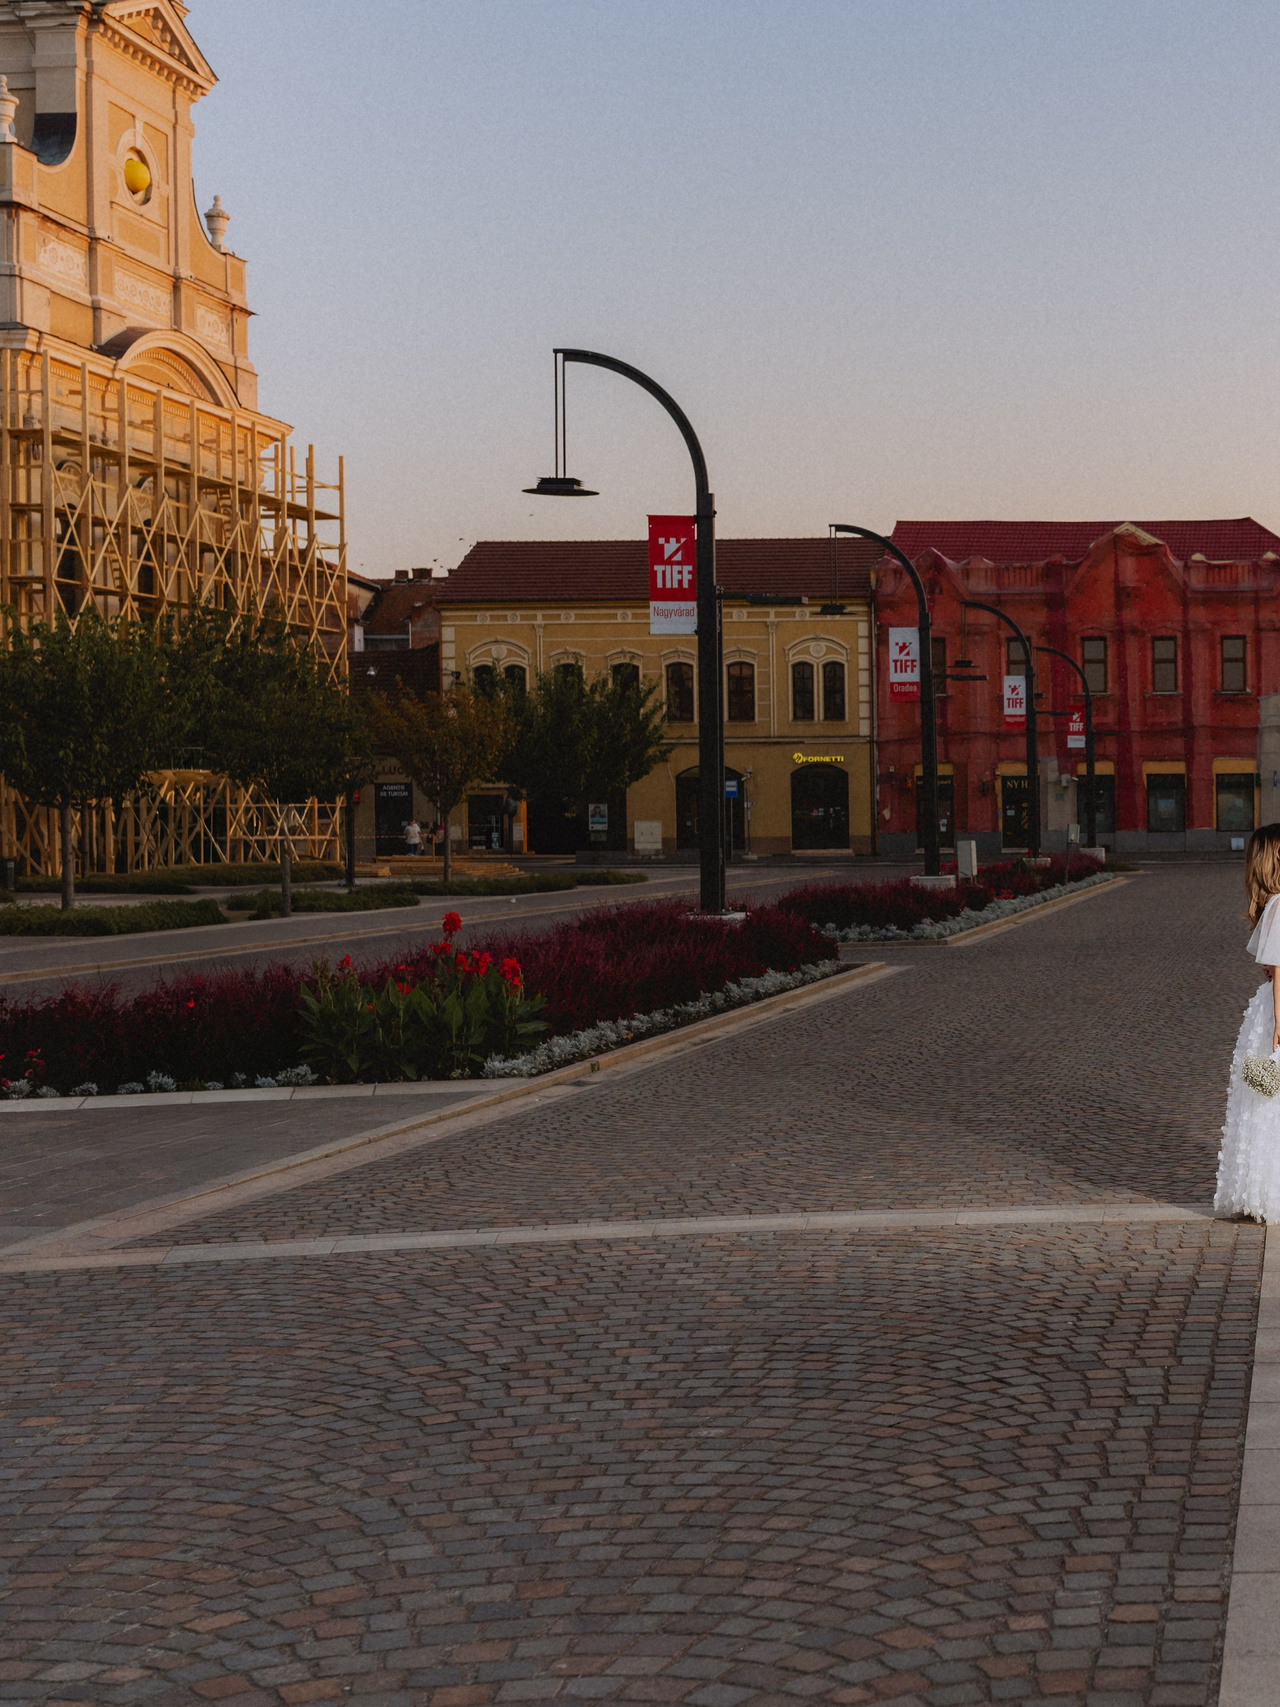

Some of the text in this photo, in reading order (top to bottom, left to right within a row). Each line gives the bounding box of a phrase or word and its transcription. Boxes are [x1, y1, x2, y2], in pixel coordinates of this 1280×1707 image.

[653, 564, 693, 589] TIFF
[653, 606, 695, 619] Nagyvárad
[892, 659, 917, 673] TIFF
[893, 683, 918, 693] Oradea
[1006, 697, 1024, 709] TIFF
[1068, 722, 1084, 732] TIFF
[803, 755, 844, 763] FORNETTI
